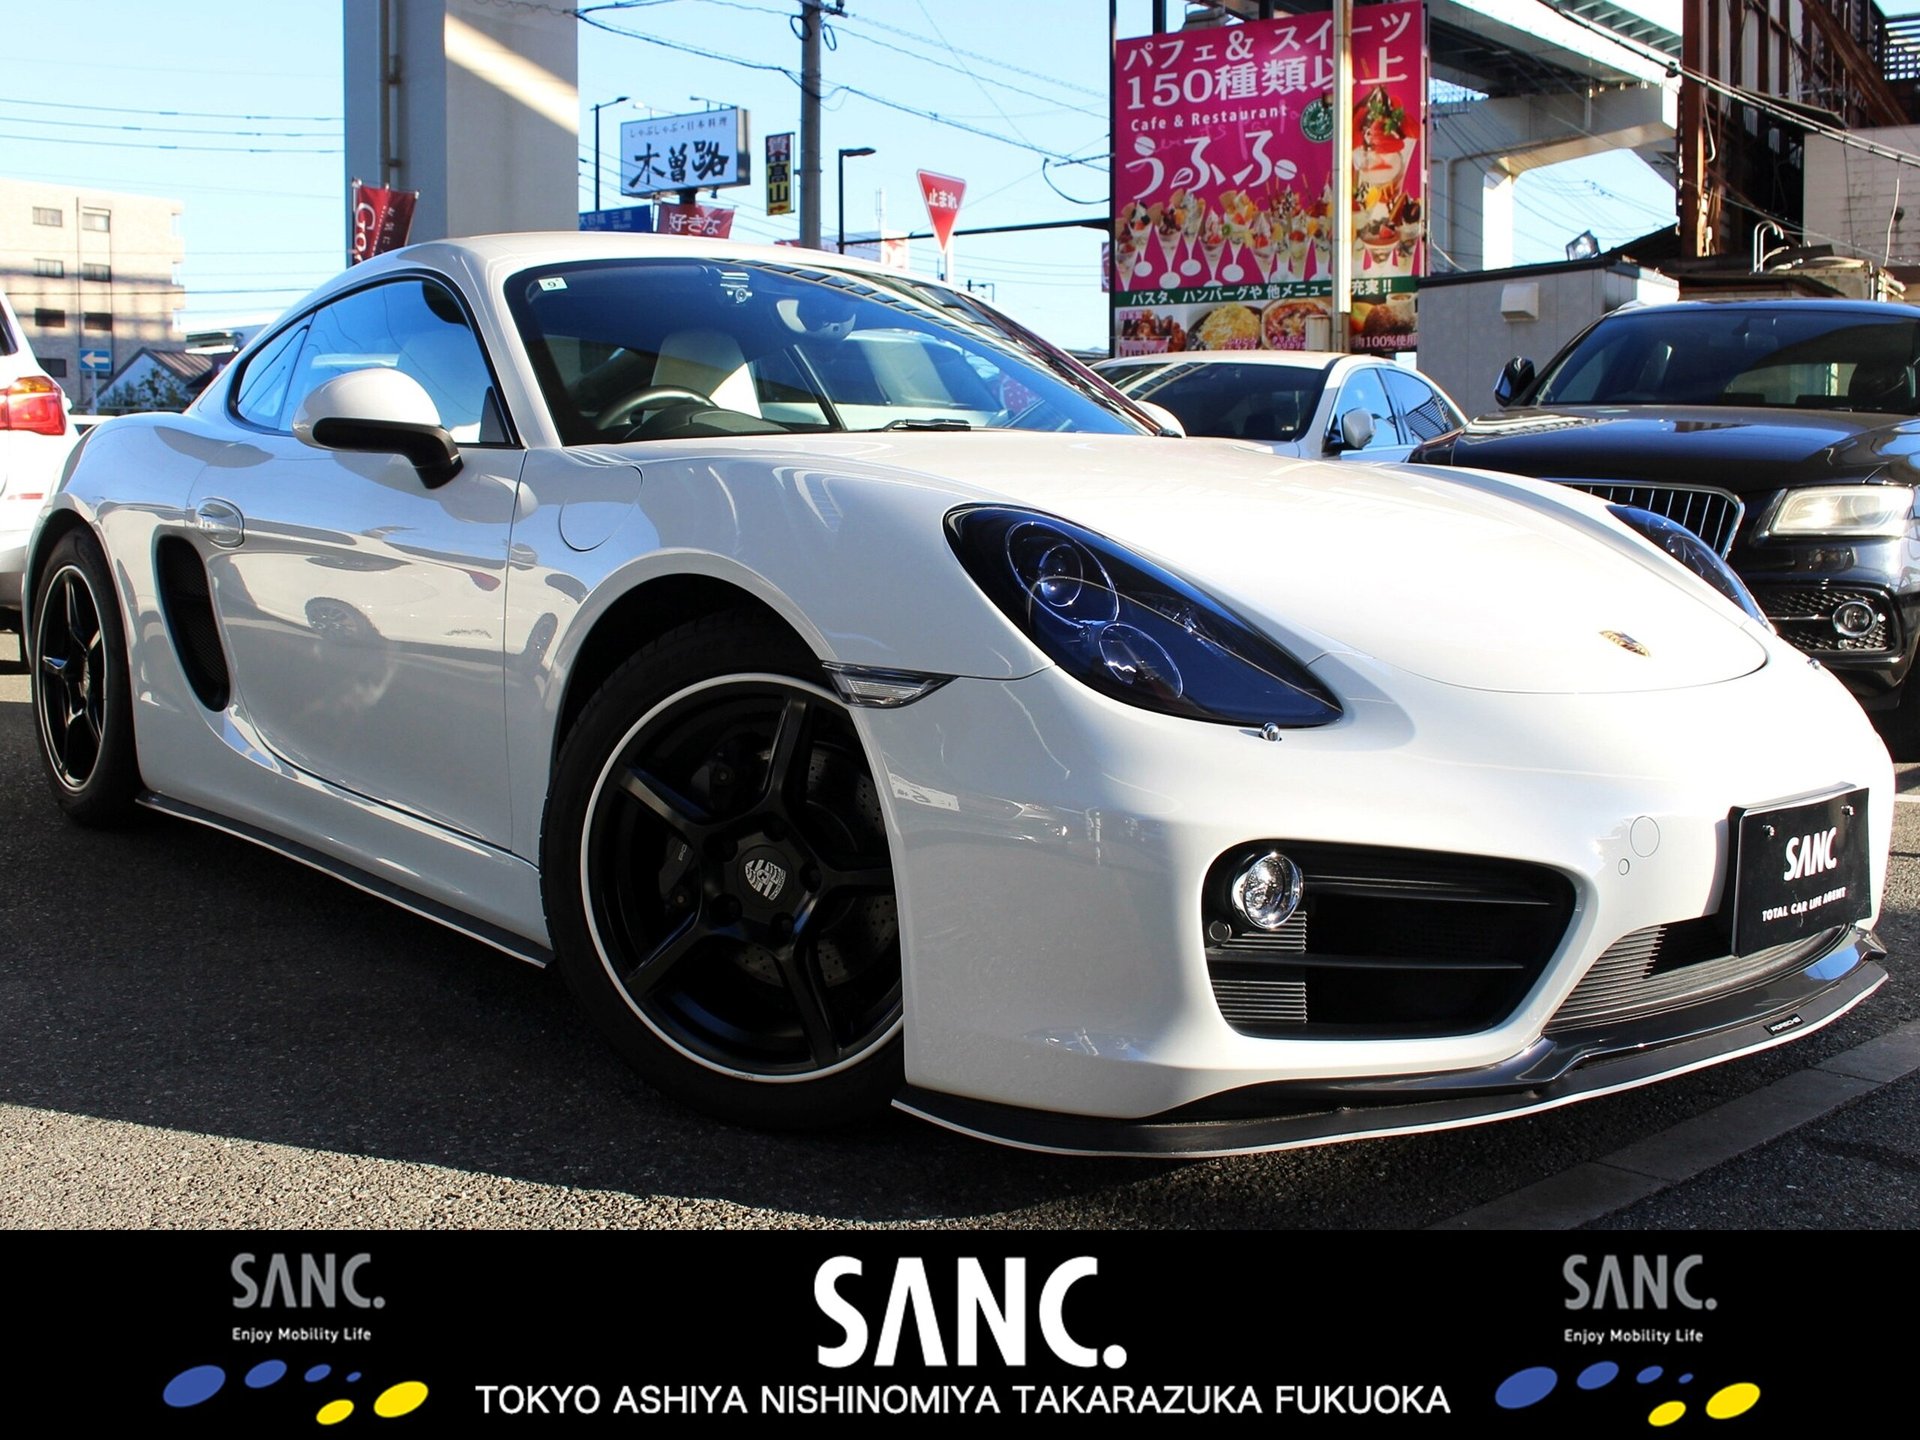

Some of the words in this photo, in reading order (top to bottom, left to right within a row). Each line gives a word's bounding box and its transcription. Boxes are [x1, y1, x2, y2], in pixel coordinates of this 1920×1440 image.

[1131, 117, 1167, 132] Cafe
[1173, 114, 1184, 128] &
[1191, 104, 1287, 126] Restaurant
[928, 187, 958, 210] 止まれ
[668, 212, 721, 235] 好きな
[1762, 905, 1788, 922] TOTAL
[1790, 901, 1808, 915] CAR
[1809, 895, 1822, 910] LIFE
[1822, 886, 1846, 904] AGENT
